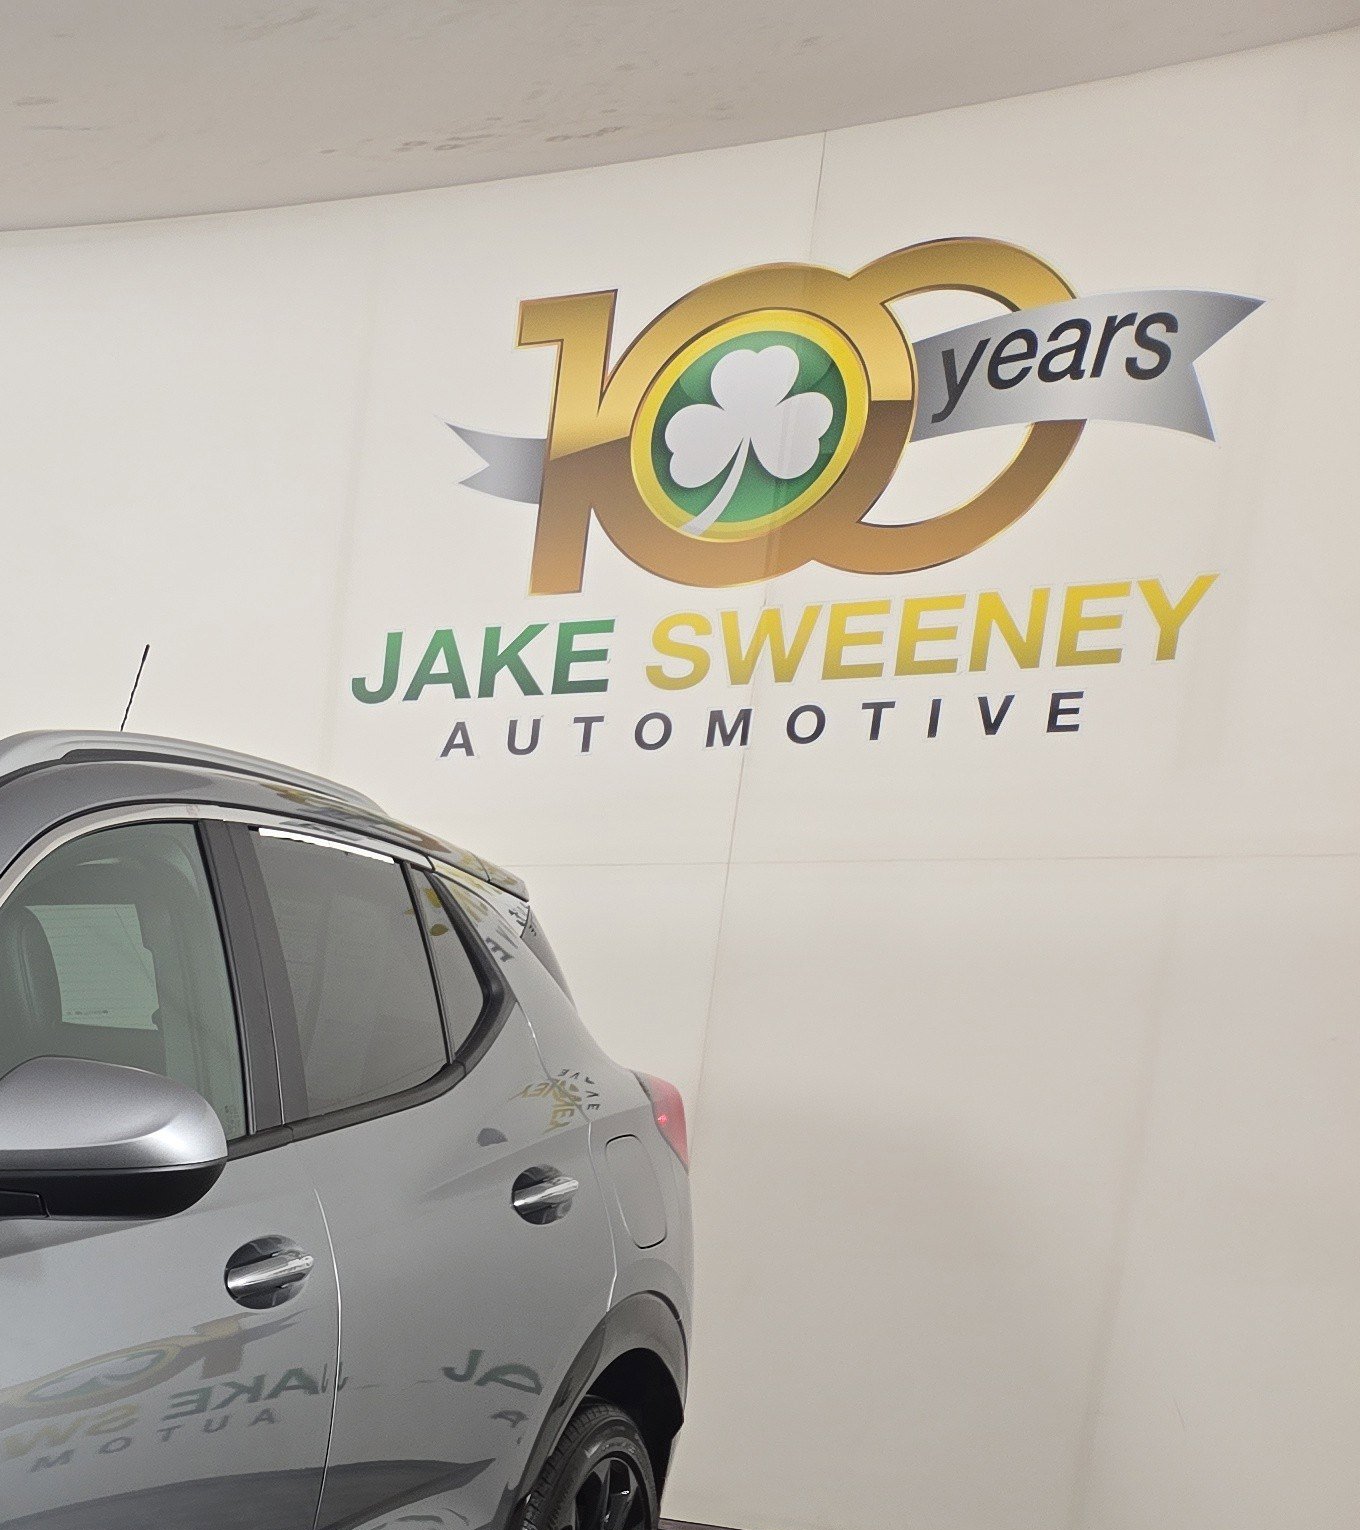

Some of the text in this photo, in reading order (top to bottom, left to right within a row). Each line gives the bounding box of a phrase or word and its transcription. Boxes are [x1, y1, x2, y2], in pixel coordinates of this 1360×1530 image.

[517, 235, 1178, 597] 100 years
[350, 573, 1219, 705] JAKE SWEENEY
[439, 691, 1085, 759] AUTOMOTIVE
